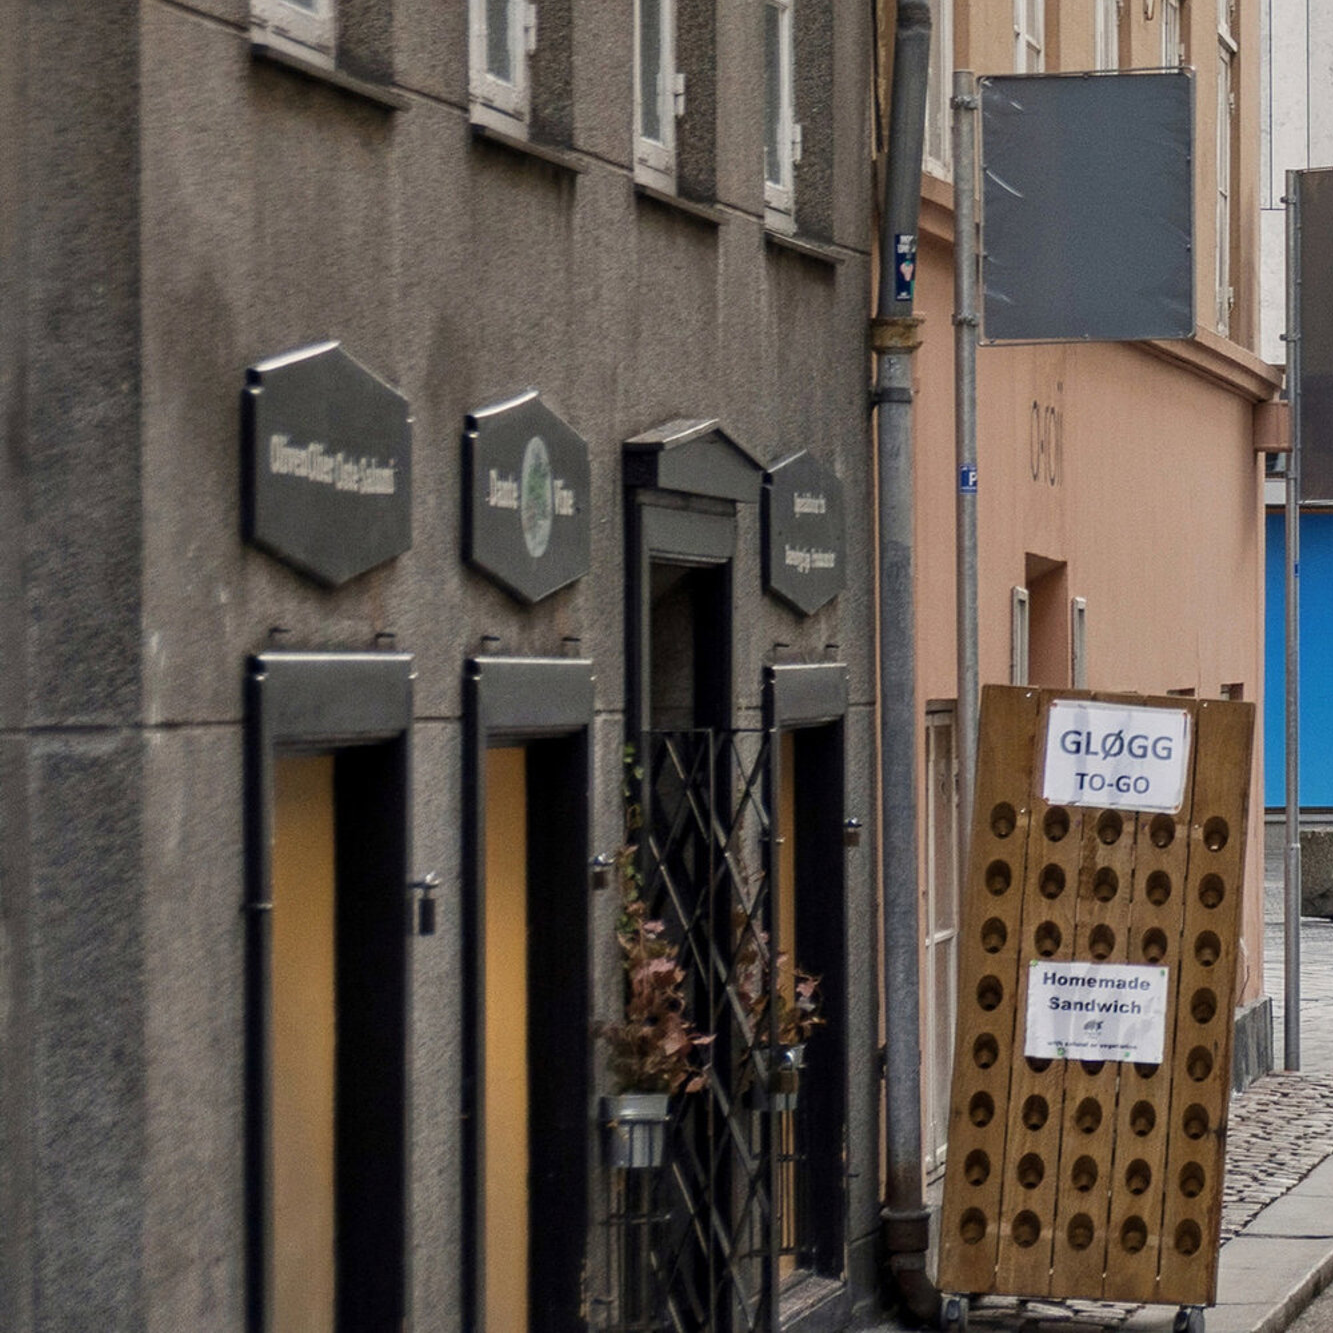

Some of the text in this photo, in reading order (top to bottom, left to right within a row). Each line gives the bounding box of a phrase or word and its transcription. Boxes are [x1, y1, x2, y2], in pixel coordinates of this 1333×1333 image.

[1059, 729, 1173, 761] GLØGG
[1075, 772, 1150, 795] TO-GO
[1043, 971, 1151, 991] Homemade
[1048, 996, 1142, 1014] Sandwich
